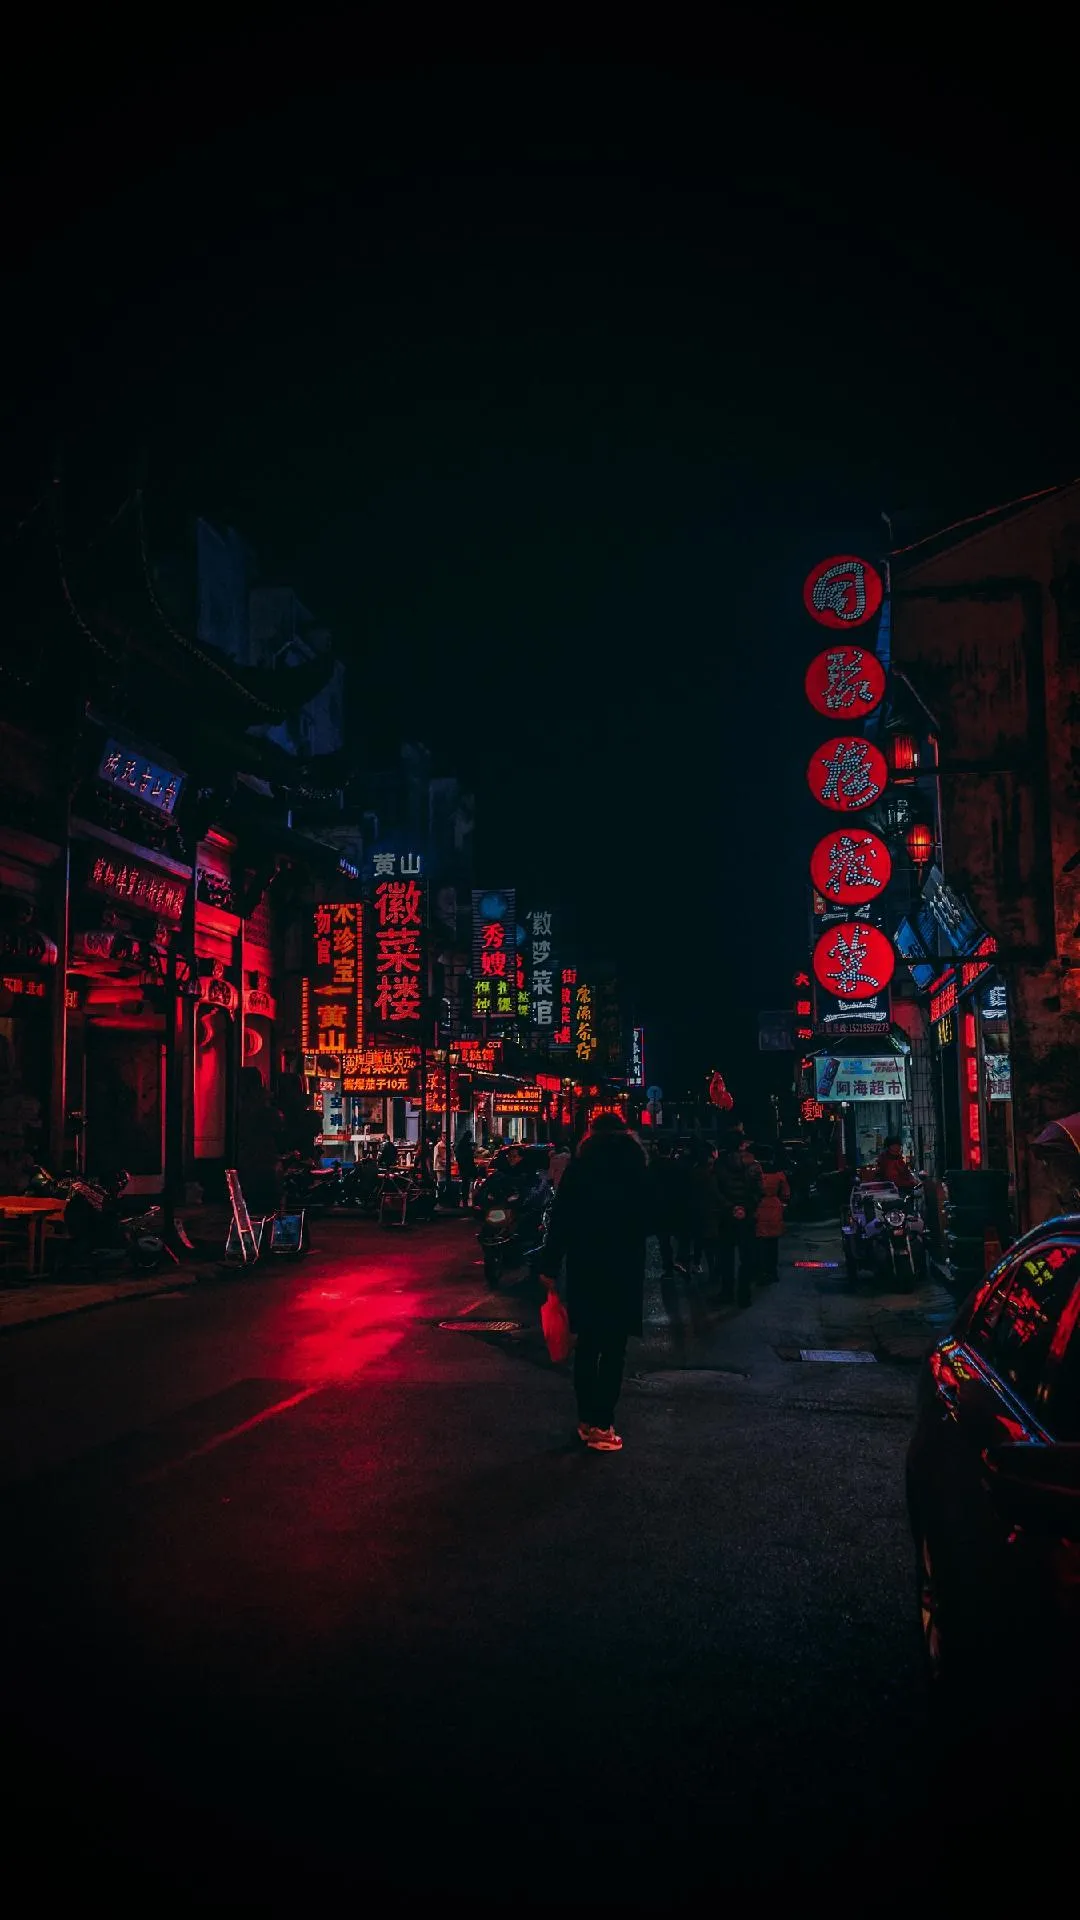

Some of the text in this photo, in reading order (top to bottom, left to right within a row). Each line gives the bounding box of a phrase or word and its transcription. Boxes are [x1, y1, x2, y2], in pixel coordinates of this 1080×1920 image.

[373, 853, 421, 876] 黄山
[373, 880, 423, 1021] 徽菜楼
[317, 1003, 348, 1051] 黄山
[836, 1080, 902, 1097] 阿海超市
